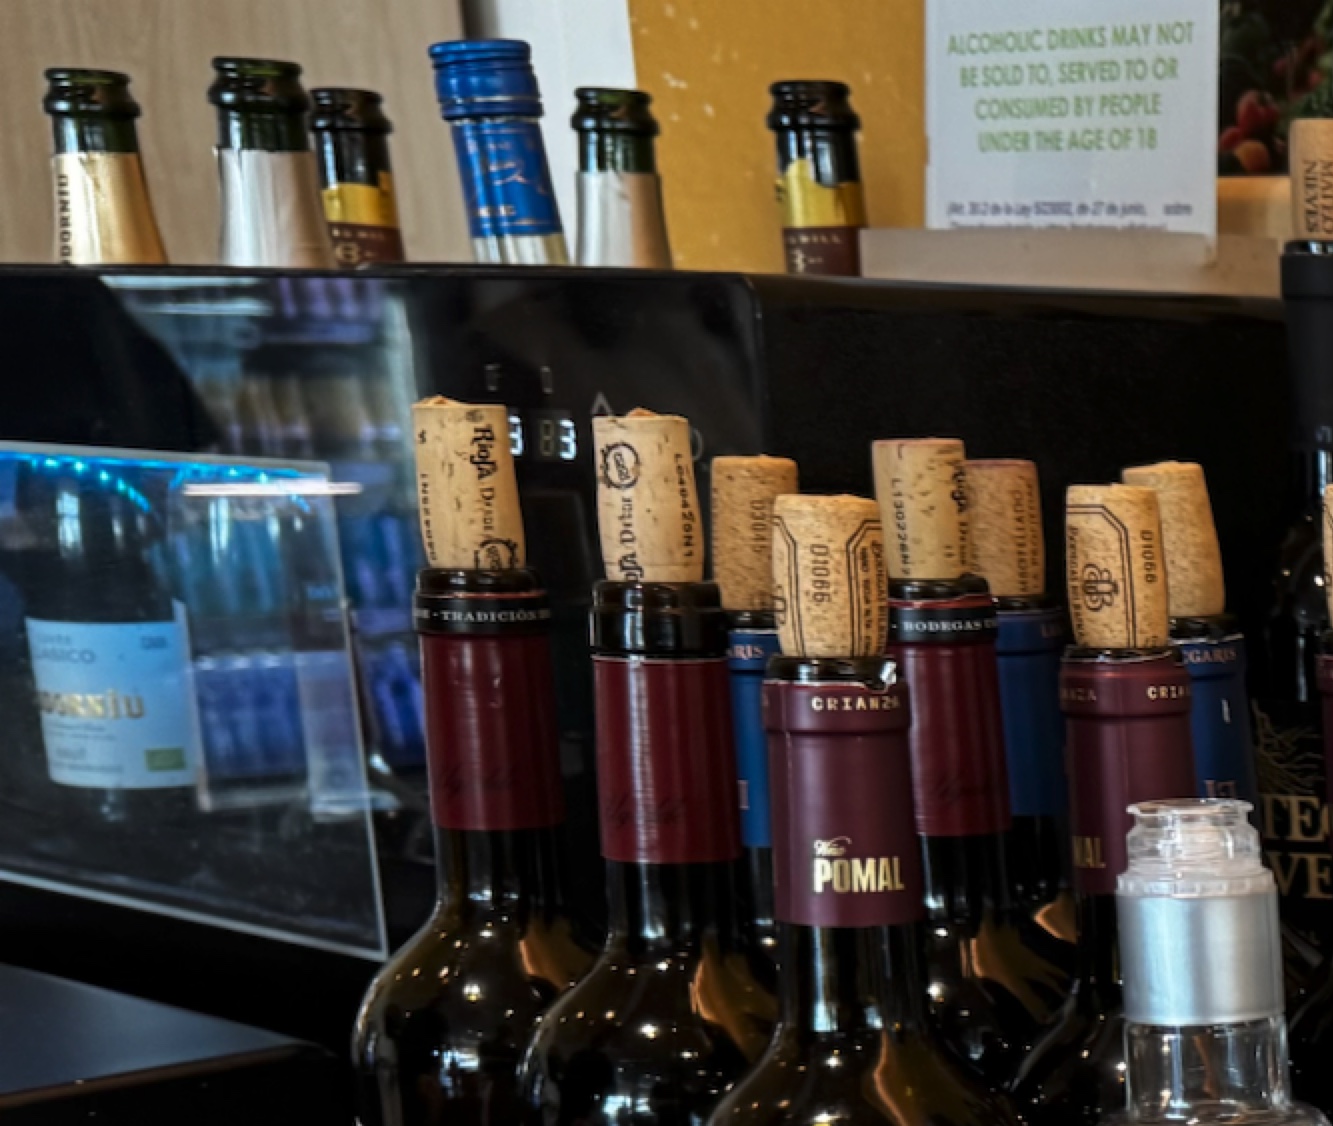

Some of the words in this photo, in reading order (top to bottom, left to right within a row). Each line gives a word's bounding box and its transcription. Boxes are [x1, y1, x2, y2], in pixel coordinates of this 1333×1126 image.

[947, 31, 1042, 55] ALCOHOLIC
[1047, 27, 1107, 51] DRINKS
[1112, 25, 1150, 47] MAY
[1157, 21, 1195, 46] NOT
[959, 66, 978, 87] BE
[981, 64, 1025, 87] SOLD
[1028, 62, 1054, 86] TO,
[1058, 60, 1120, 84] SERVED
[1124, 59, 1149, 81] TO
[1152, 57, 1180, 81] OR
[975, 97, 1070, 121] CONSUMED
[1074, 95, 1098, 118] BY
[1101, 93, 1162, 116] PEOPLE
[978, 131, 1031, 153] UNDER
[1034, 130, 1064, 152] THE
[1067, 128, 1105, 151] AGE
[1107, 127, 1133, 150] OF
[1138, 127, 1158, 150] 18
[813, 856, 904, 893] POMAL
